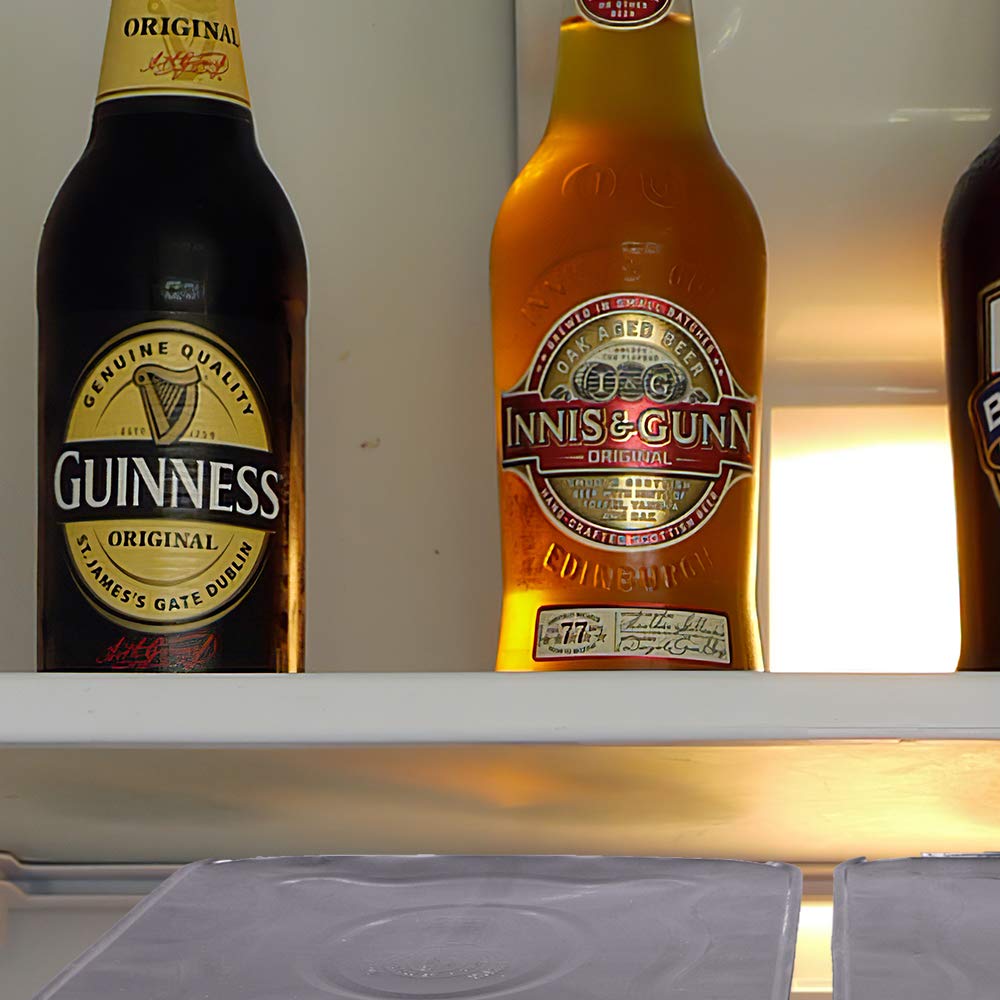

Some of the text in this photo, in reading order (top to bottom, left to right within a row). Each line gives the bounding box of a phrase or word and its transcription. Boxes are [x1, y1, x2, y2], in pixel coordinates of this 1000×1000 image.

[124, 17, 240, 47] ORIGINAL
[557, 320, 704, 376] OAK AGED BEER
[84, 341, 254, 416] GENUINE QUALITY
[54, 450, 280, 520] GUINNESS
[588, 450, 672, 465] ORIGINAL
[108, 530, 218, 550] ORIGINAL
[86, 555, 146, 609] JAMES'S
[154, 591, 203, 611] GATE
[206, 542, 253, 598] DUBLIN
